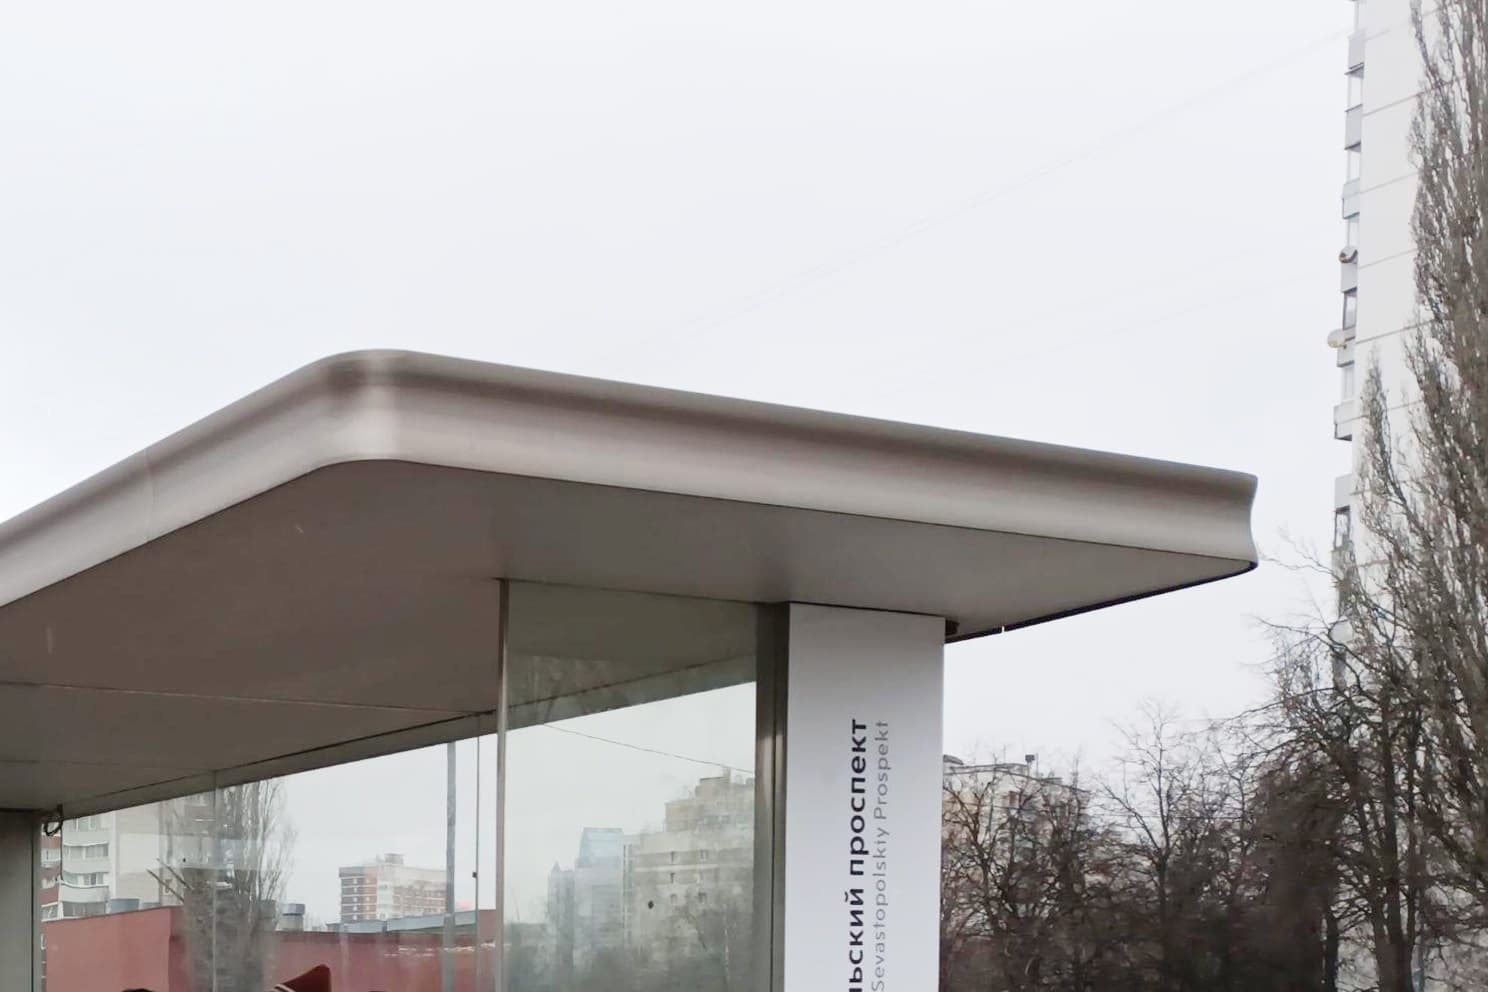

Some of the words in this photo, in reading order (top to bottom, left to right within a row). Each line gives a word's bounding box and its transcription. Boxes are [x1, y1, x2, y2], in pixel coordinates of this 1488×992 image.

[850, 718, 870, 876] проспект
[874, 719, 892, 820] Prospekt
[871, 826, 890, 992] Sevastopolskiy
